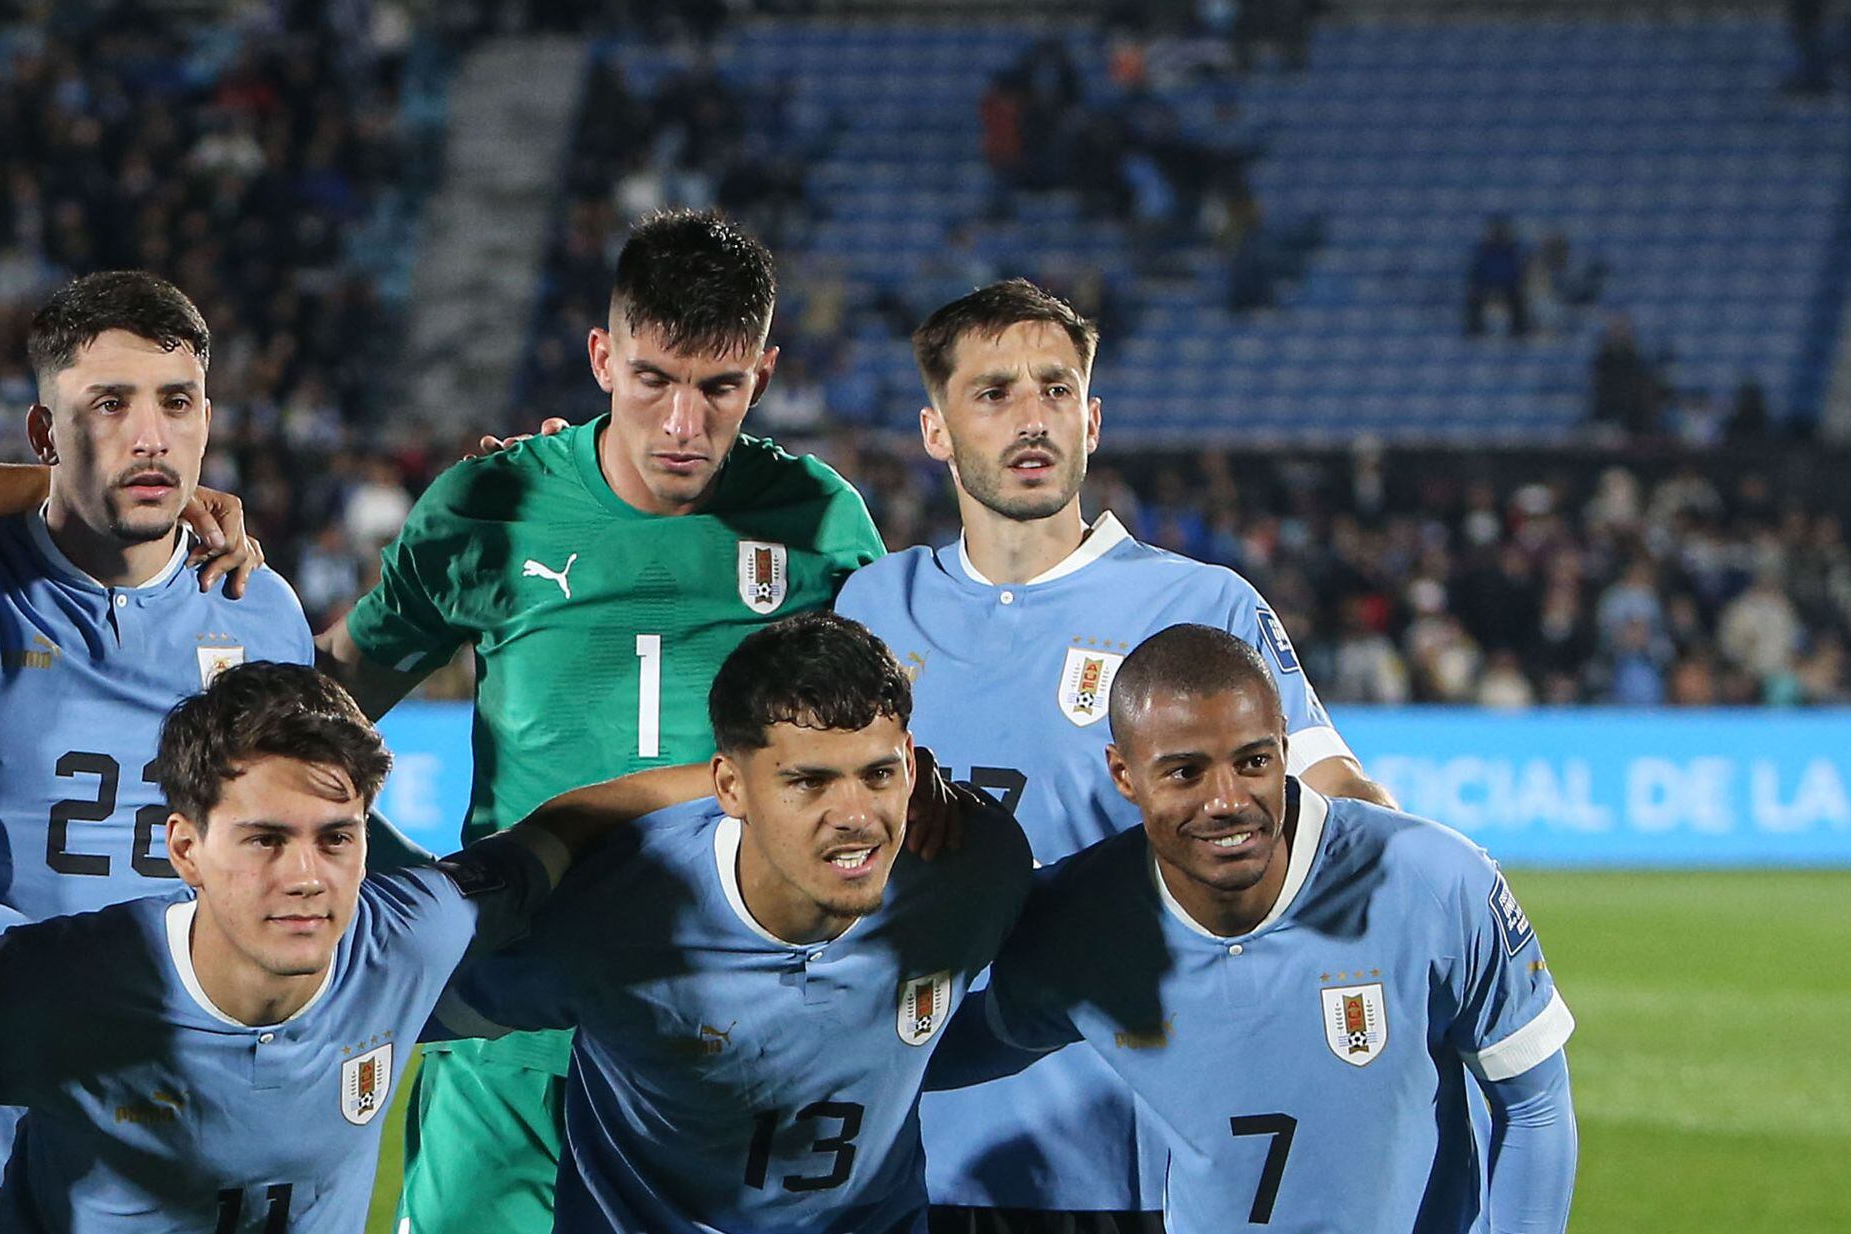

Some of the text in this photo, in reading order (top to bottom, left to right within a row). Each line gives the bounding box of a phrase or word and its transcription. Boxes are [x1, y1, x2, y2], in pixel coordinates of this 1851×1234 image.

[636, 634, 662, 757] 1
[1626, 754, 1735, 834] DE
[1751, 757, 1851, 834] LA
[742, 1099, 865, 1193] 13
[1230, 1113, 1298, 1225] 7
